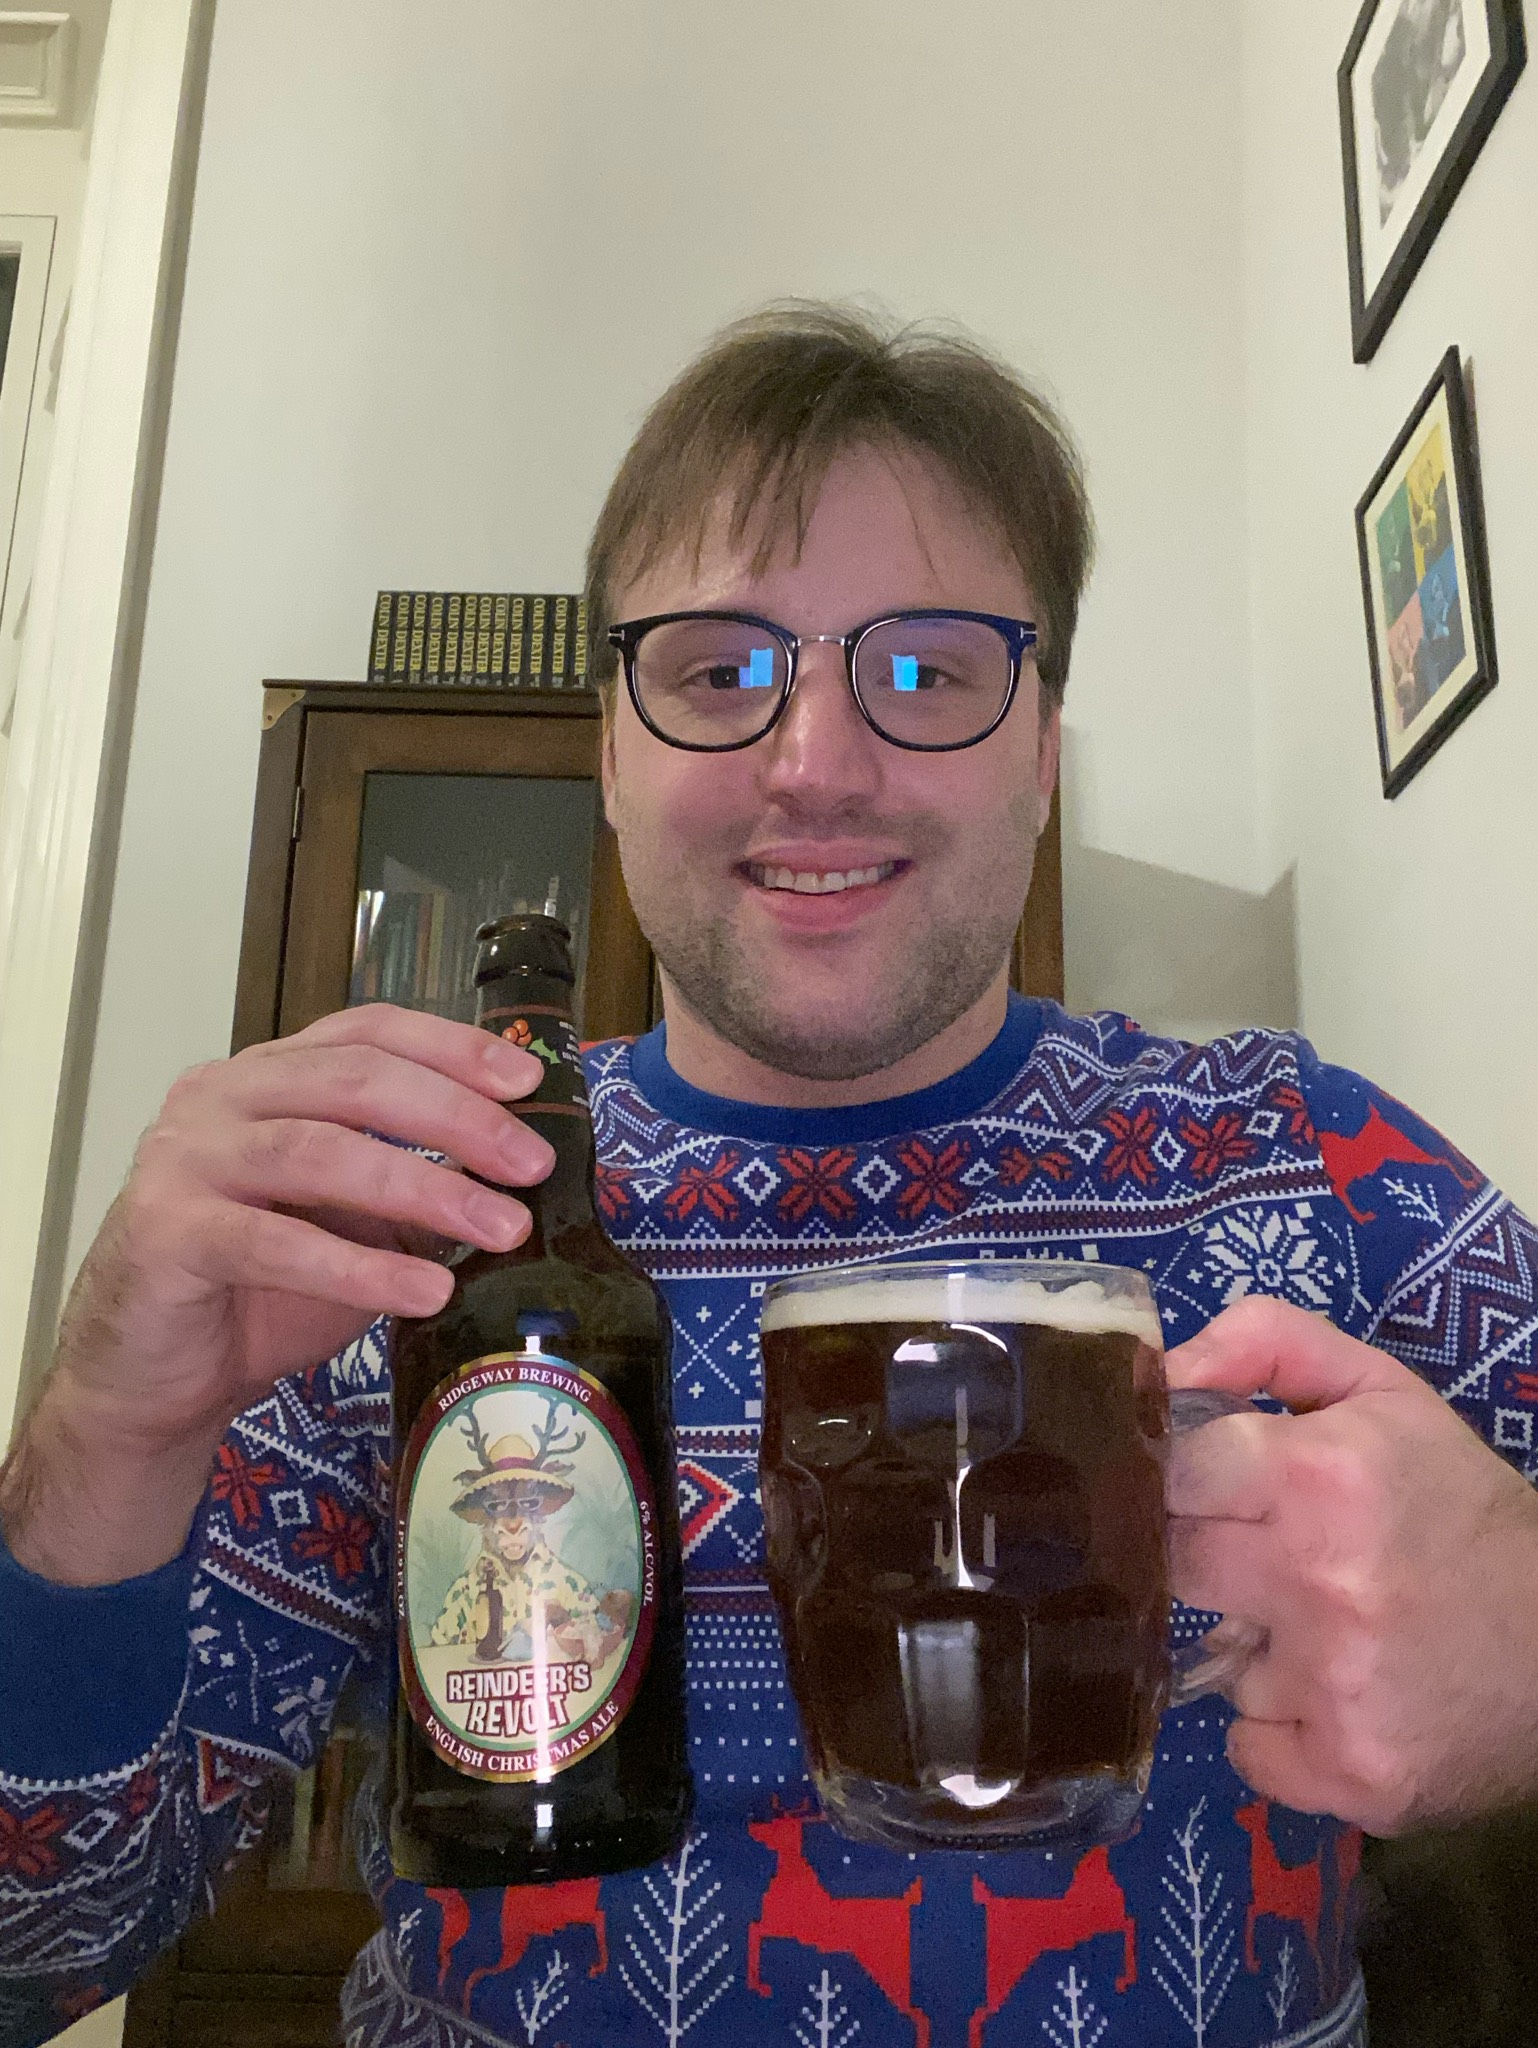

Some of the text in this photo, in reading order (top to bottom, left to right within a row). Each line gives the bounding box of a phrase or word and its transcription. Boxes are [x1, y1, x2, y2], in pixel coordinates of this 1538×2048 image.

[375, 594, 392, 670] COLIN DEXTER
[393, 596, 410, 672] COLIN DEXTER
[409, 594, 426, 670] COLIN DEXTER
[427, 597, 444, 672] COLIN DEXTER
[445, 596, 461, 672] COLIN DEXTER
[461, 596, 477, 672] COLIN DEXTER
[476, 597, 492, 673] COLIN DEXTER
[492, 597, 506, 673] COLIN DEXTER
[509, 598, 524, 674] COLIN DEXTER
[530, 598, 546, 674] COLIN DEXTER
[552, 598, 568, 674] COLIN DEXTER
[438, 1367, 593, 1412] RIDGEWAY BREWING
[639, 1500, 651, 1526] 6%
[425, 1715, 484, 1768] ENGLISH
[590, 1700, 619, 1737] ALE
[466, 1694, 570, 1737] REVOLT
